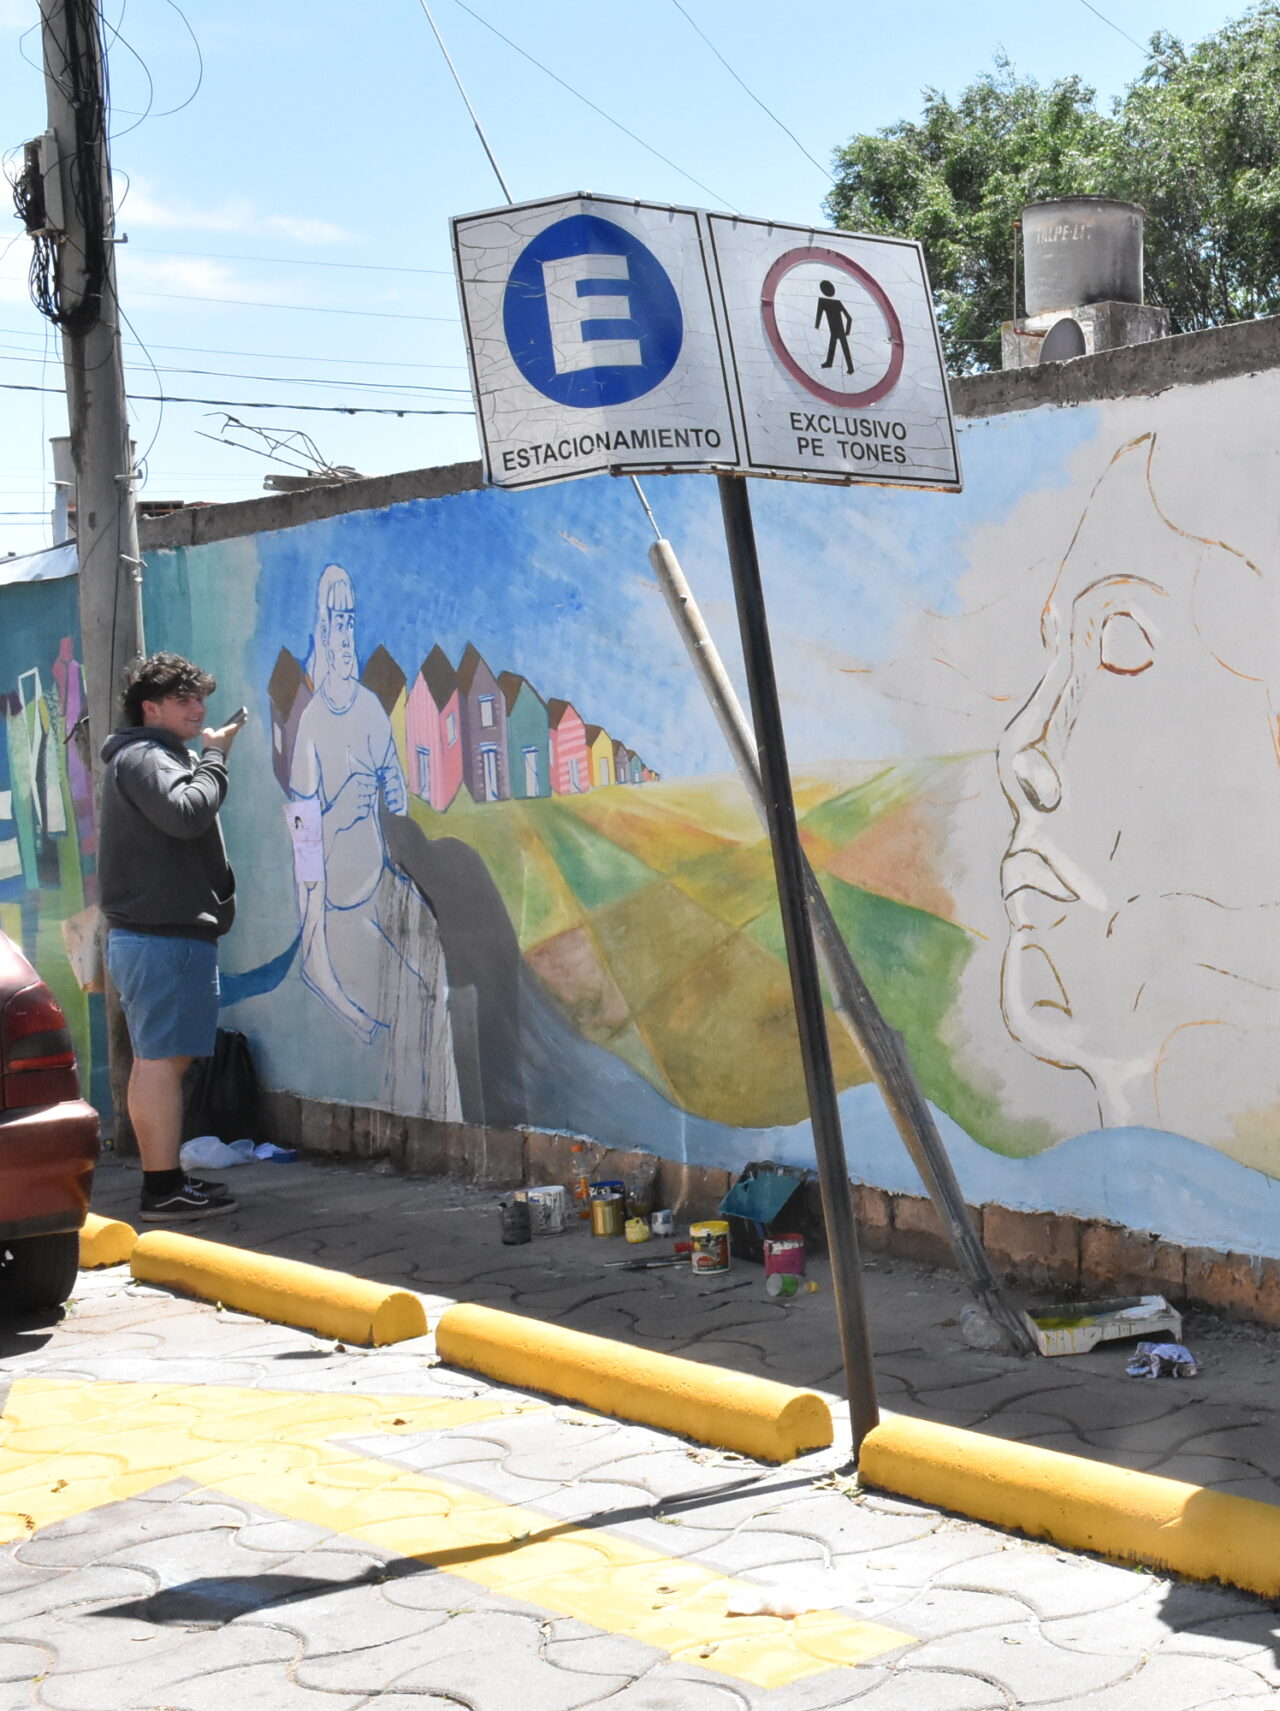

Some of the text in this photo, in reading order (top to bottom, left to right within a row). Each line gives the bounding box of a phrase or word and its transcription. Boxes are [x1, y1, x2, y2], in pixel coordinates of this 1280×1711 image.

[541, 253, 643, 375] E
[789, 412, 907, 440] EXCLUSIVO
[502, 428, 721, 472] ESTACIONAMIENTO
